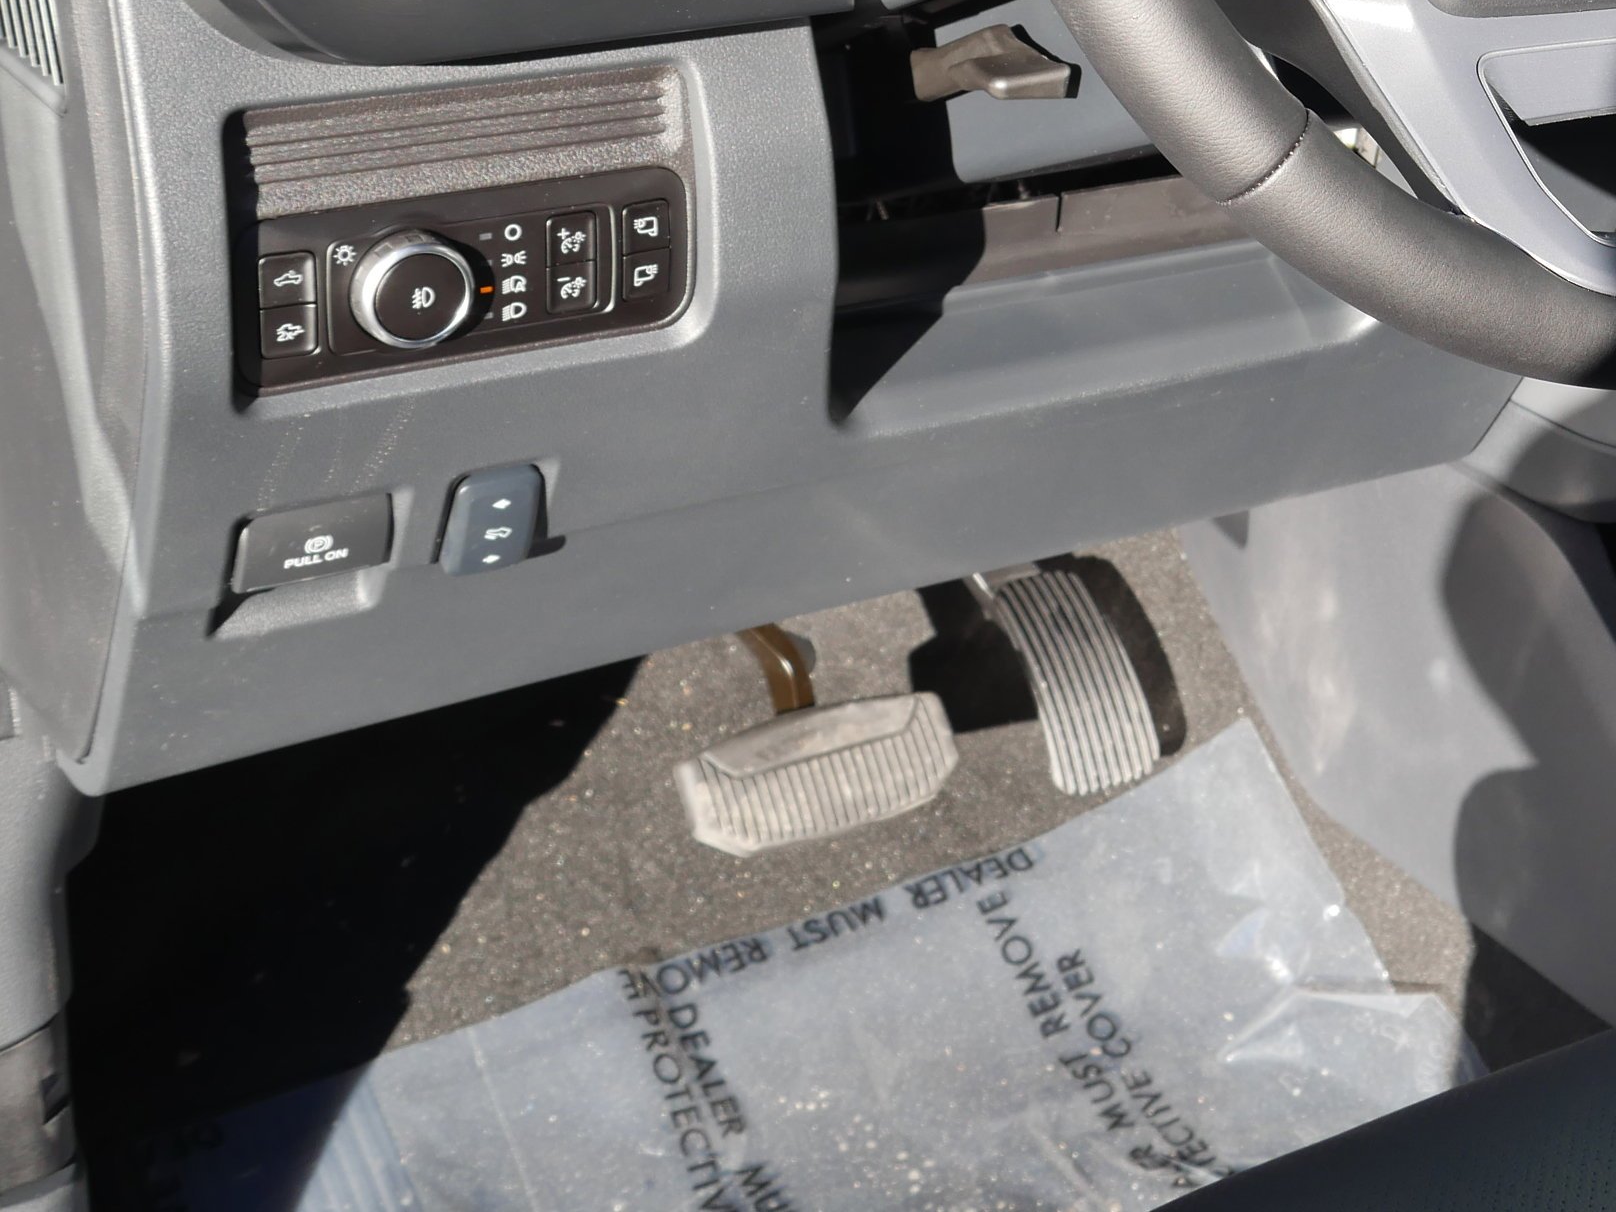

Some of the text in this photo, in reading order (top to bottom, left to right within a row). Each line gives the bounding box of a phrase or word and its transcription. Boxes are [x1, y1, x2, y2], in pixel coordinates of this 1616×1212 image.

[283, 548, 349, 569] PULL ON
[903, 848, 1034, 909] DEALER
[786, 894, 887, 951] MUST
[976, 892, 1071, 1039] REMOVE
[1056, 948, 1132, 1059] COVER
[667, 1003, 747, 1138] DEALER
[1058, 1053, 1135, 1131] MUST
